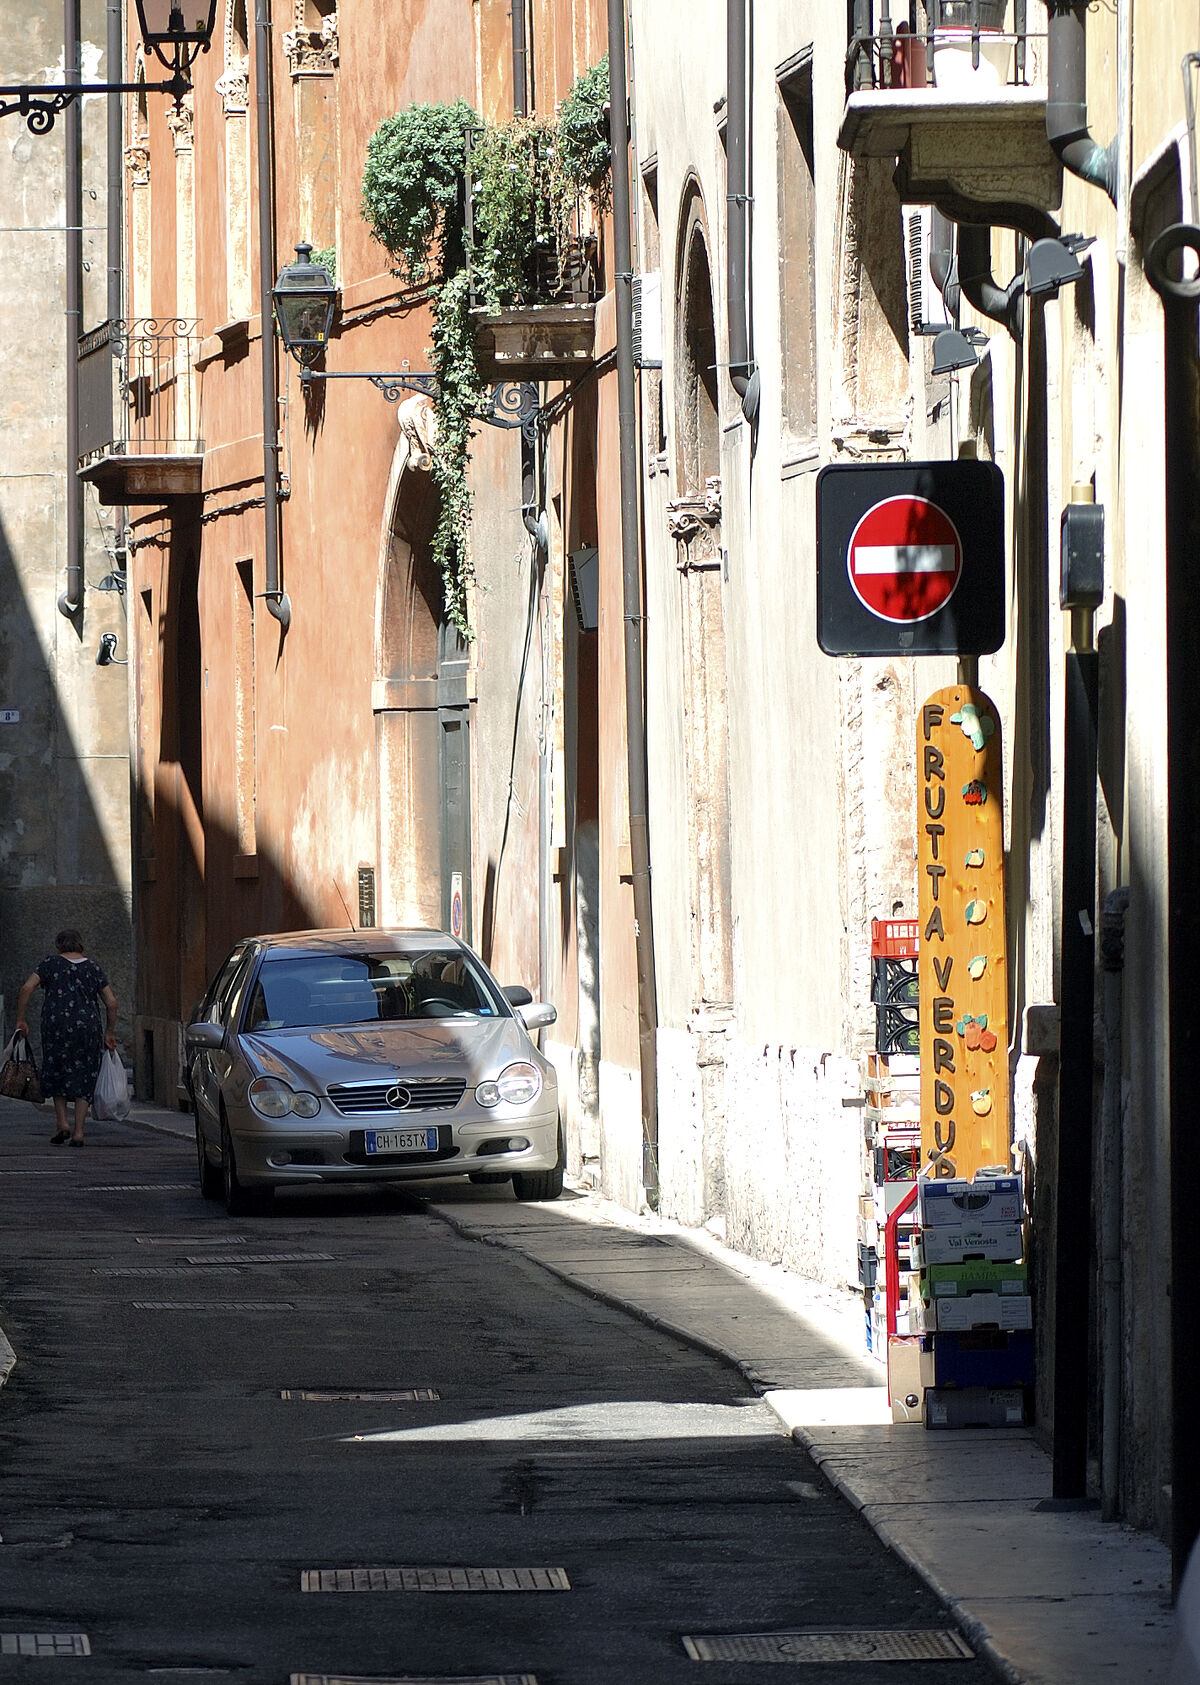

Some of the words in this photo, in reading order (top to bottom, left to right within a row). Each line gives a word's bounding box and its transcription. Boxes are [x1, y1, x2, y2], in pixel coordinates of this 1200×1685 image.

[923, 704, 946, 941] FRUTTA
[948, 1239, 962, 1247] Val
[964, 1238, 998, 1247] Venosta
